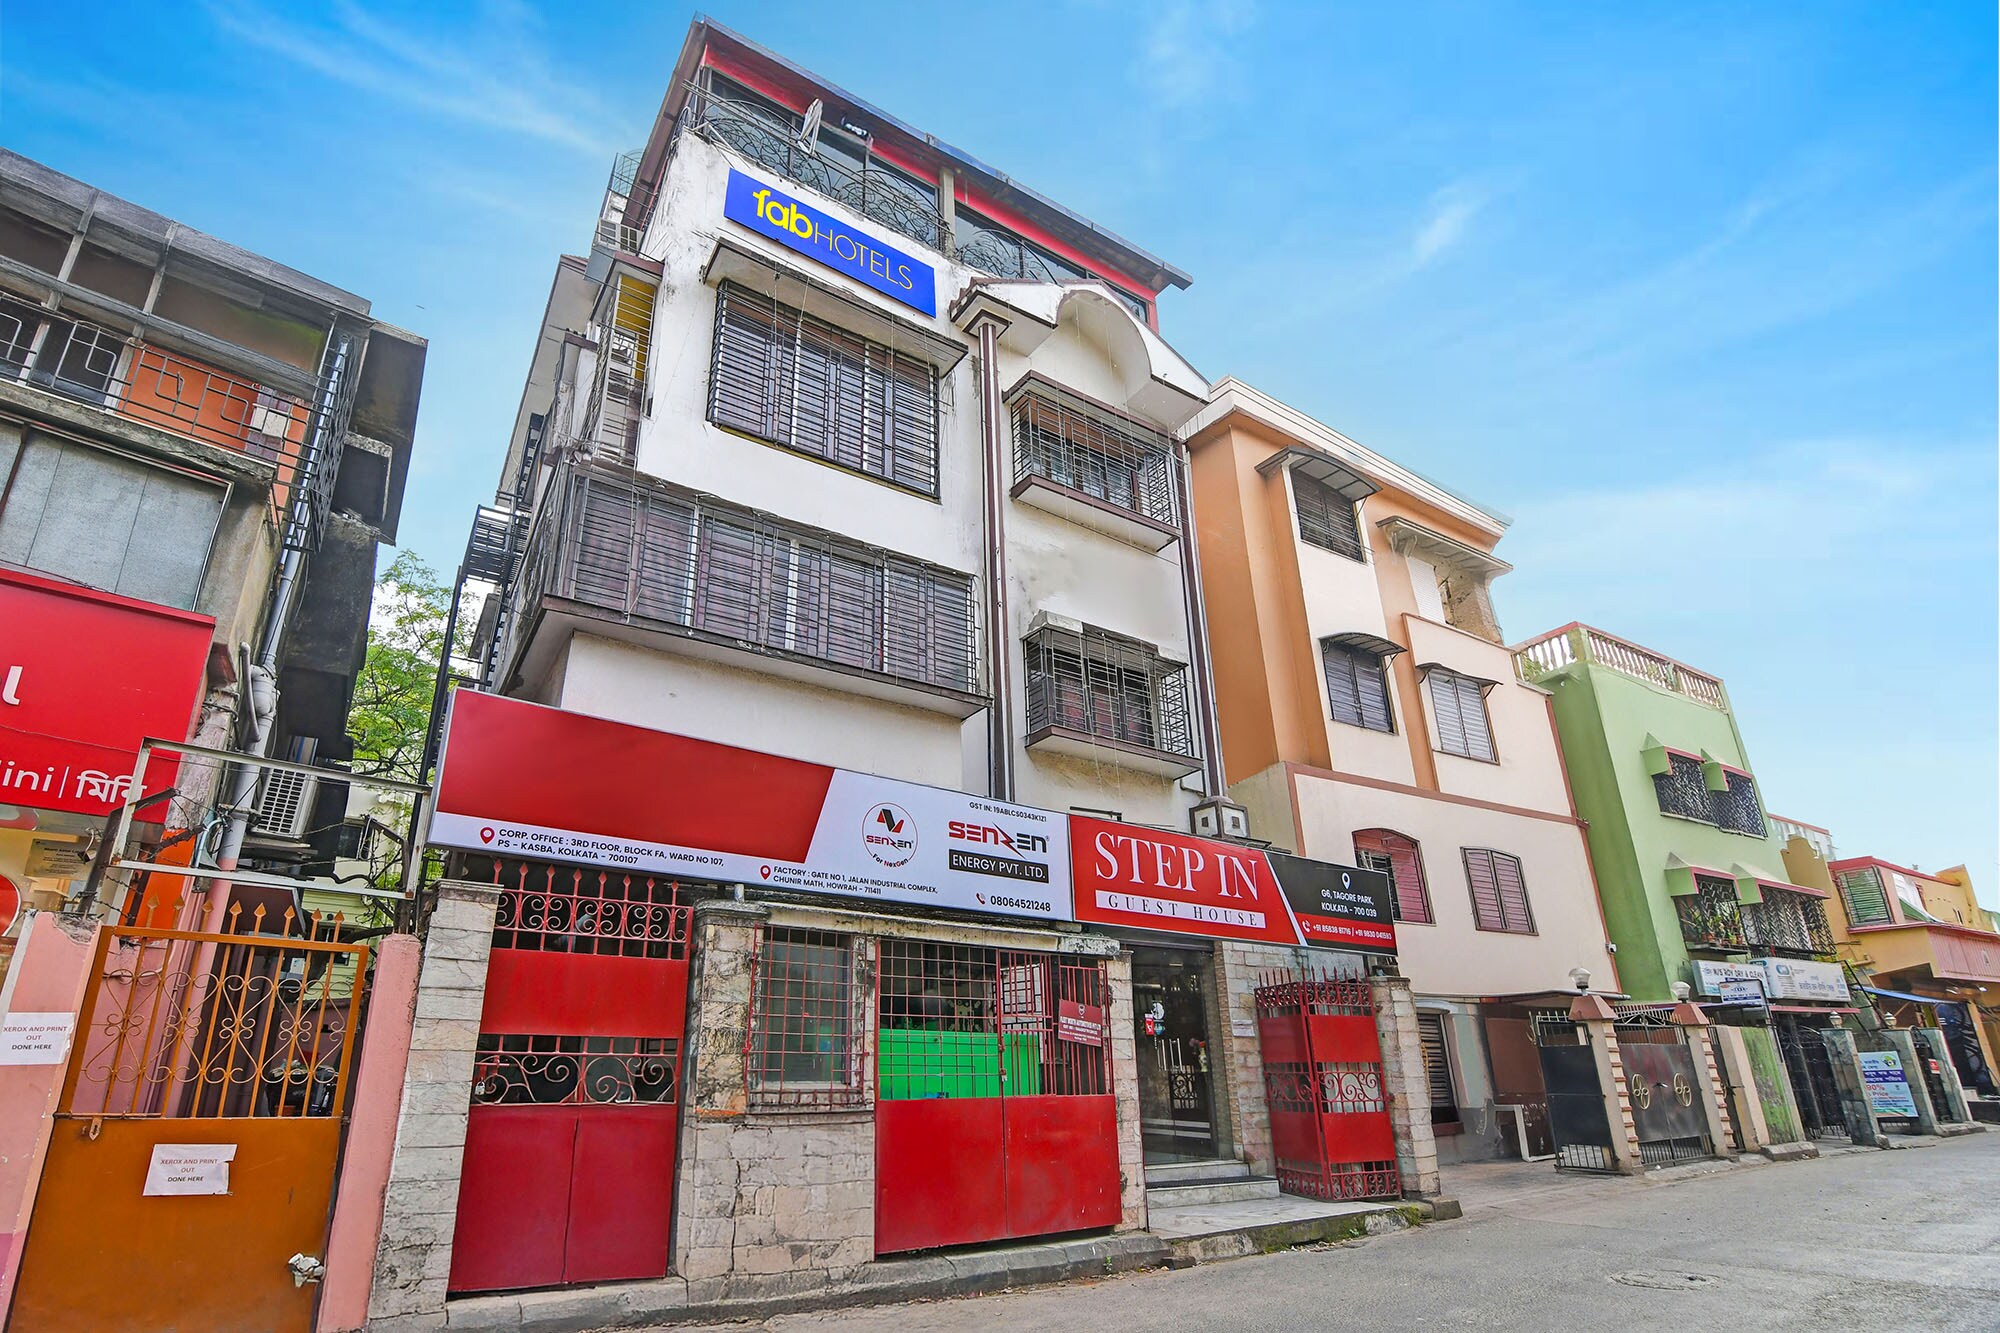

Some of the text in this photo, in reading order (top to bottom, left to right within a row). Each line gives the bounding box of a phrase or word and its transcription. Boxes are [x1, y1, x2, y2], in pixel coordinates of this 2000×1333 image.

[498, 828, 528, 840] CORP.
[531, 833, 564, 844] OFFICE
[571, 838, 589, 848] 3RD
[591, 841, 623, 853] FLOOR,
[624, 846, 653, 857] BLOCK
[655, 850, 667, 860] FA,
[669, 852, 695, 862] WARD
[696, 856, 709, 864] NO
[710, 858, 724, 866] 107,
[498, 839, 510, 848] PS
[520, 842, 556, 855] KASBA,
[558, 847, 599, 860] KOLKATA
[609, 854, 638, 864] 700107
[872, 853, 909, 868] For NexGen
[952, 854, 1046, 879] ENERGY PVT. LTD.
[1095, 831, 1258, 901] STEP IN
[773, 866, 806, 877] FACTORY
[811, 871, 829, 879] GATE
[848, 876, 869, 884] JALAN
[870, 879, 906, 889] INDUSTRIAL
[907, 884, 938, 893] COMPLEX,
[773, 875, 801, 885] CHUNIR
[803, 879, 825, 888] MATH,
[826, 882, 857, 891] HOWRAH
[864, 886, 882, 895] 711411
[990, 896, 1051, 912] 08064521248
[1321, 889, 1374, 905] G6, TAGORE PARK,
[1321, 902, 1348, 913] KOLKATA
[1354, 906, 1365, 915] 700
[1366, 908, 1377, 917] 039
[1108, 894, 1257, 926] GUEST HOUSE
